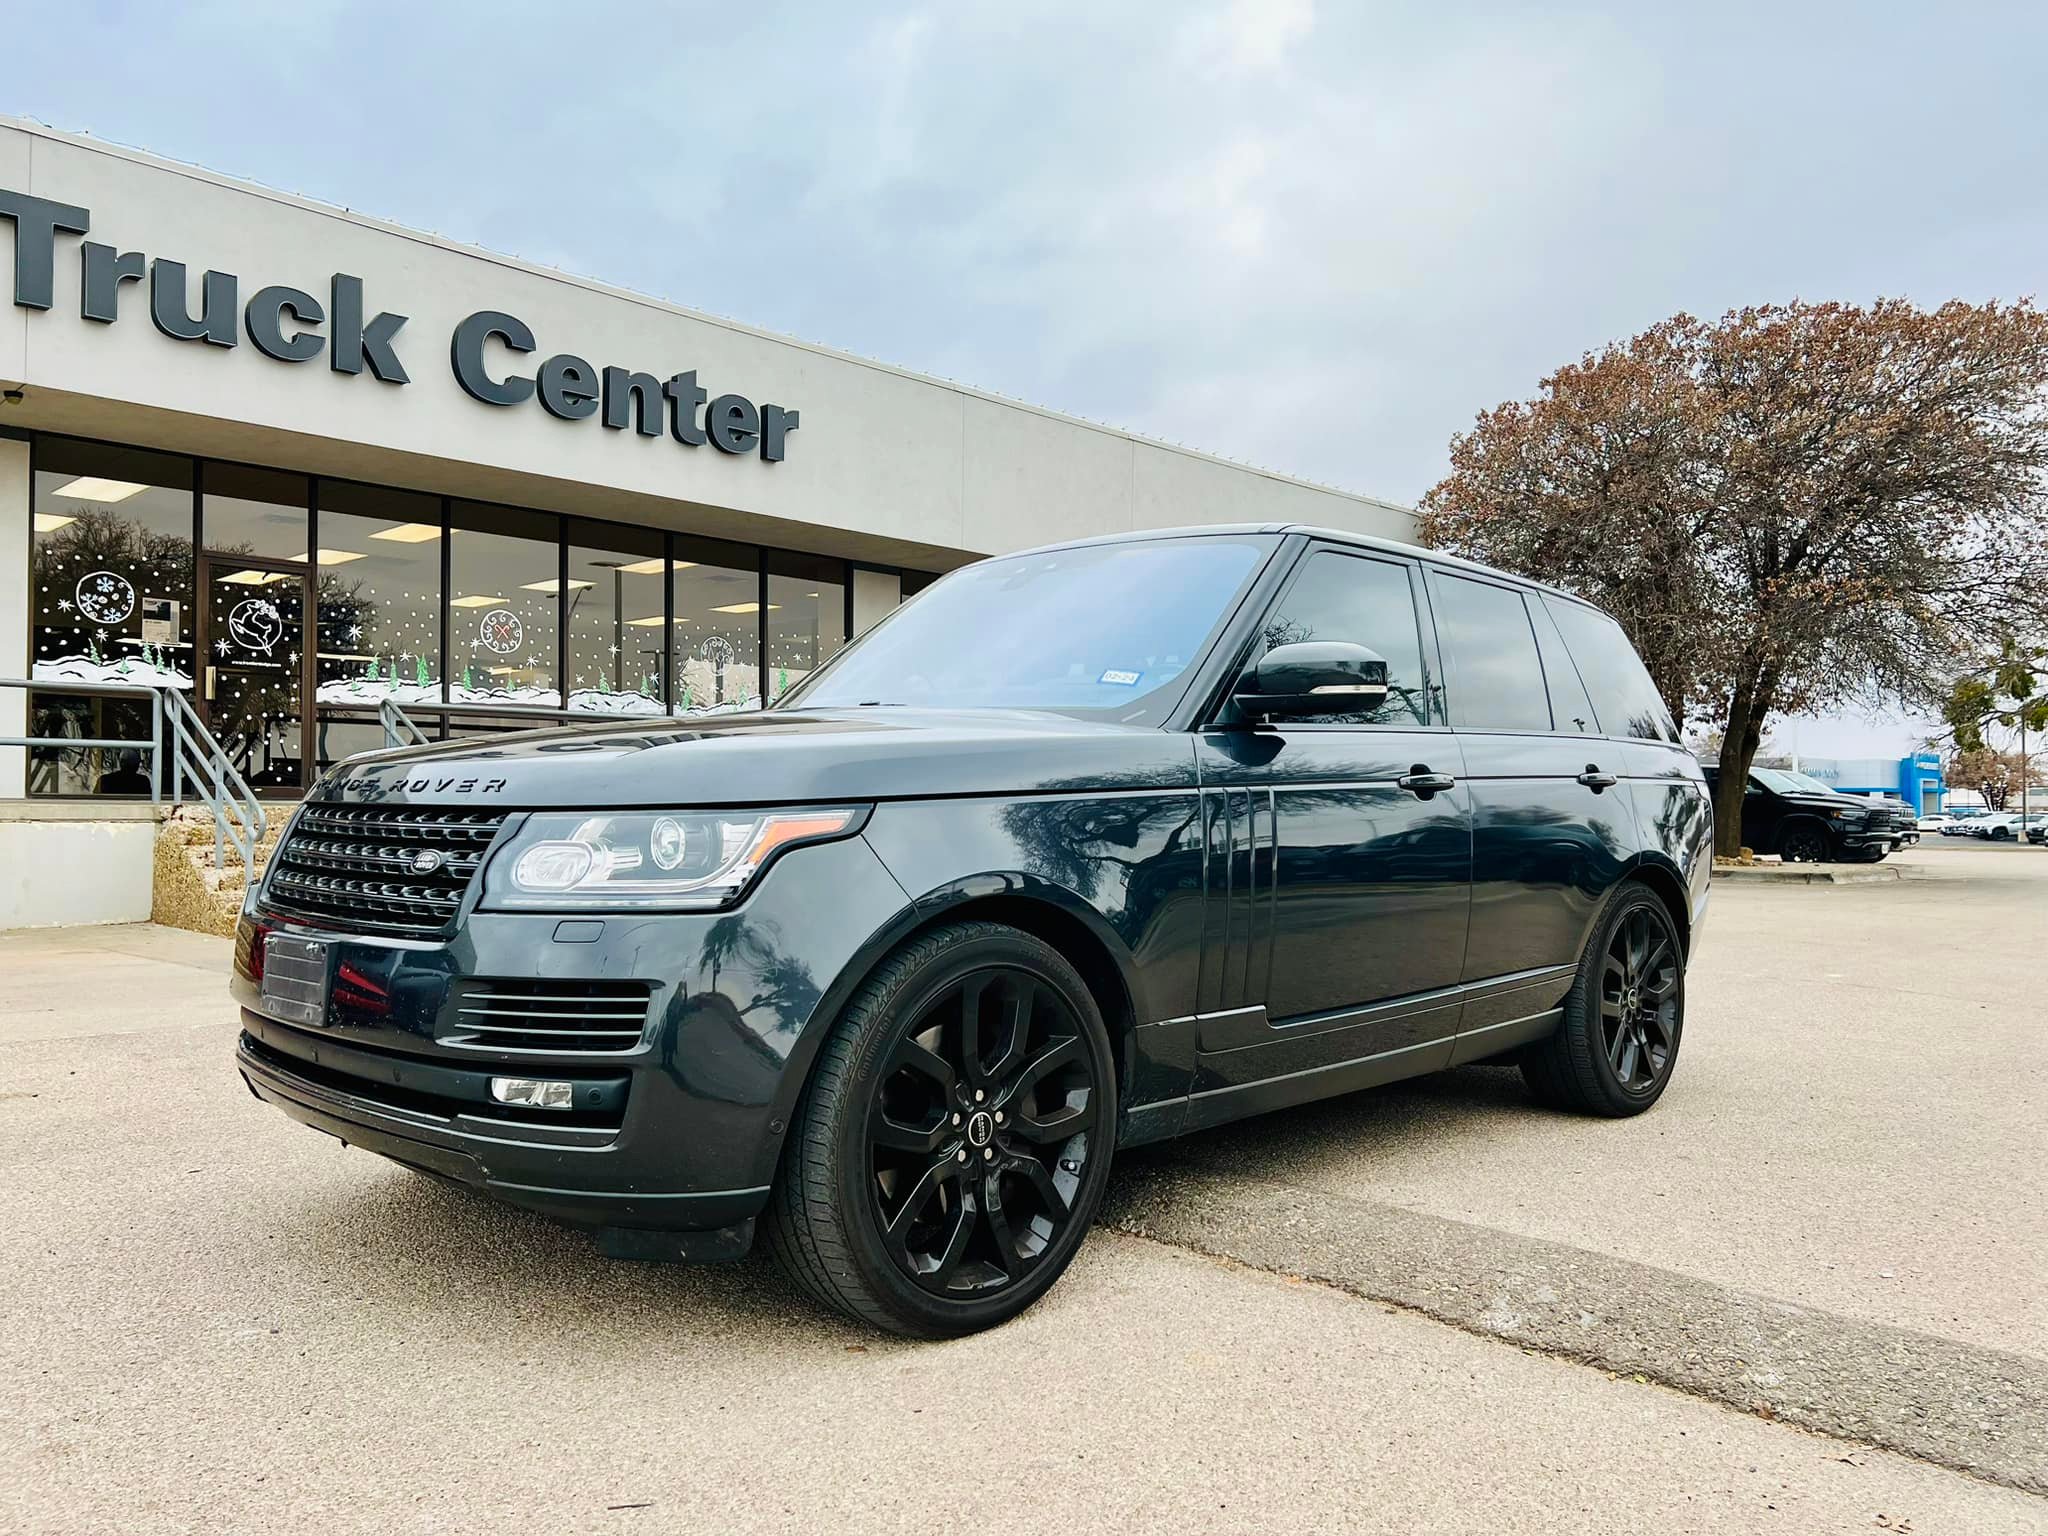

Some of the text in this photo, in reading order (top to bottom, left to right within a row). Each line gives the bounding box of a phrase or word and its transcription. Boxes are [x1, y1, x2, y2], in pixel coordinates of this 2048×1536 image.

[0, 190, 800, 462] Truck Center
[388, 778, 507, 793] ROVER
